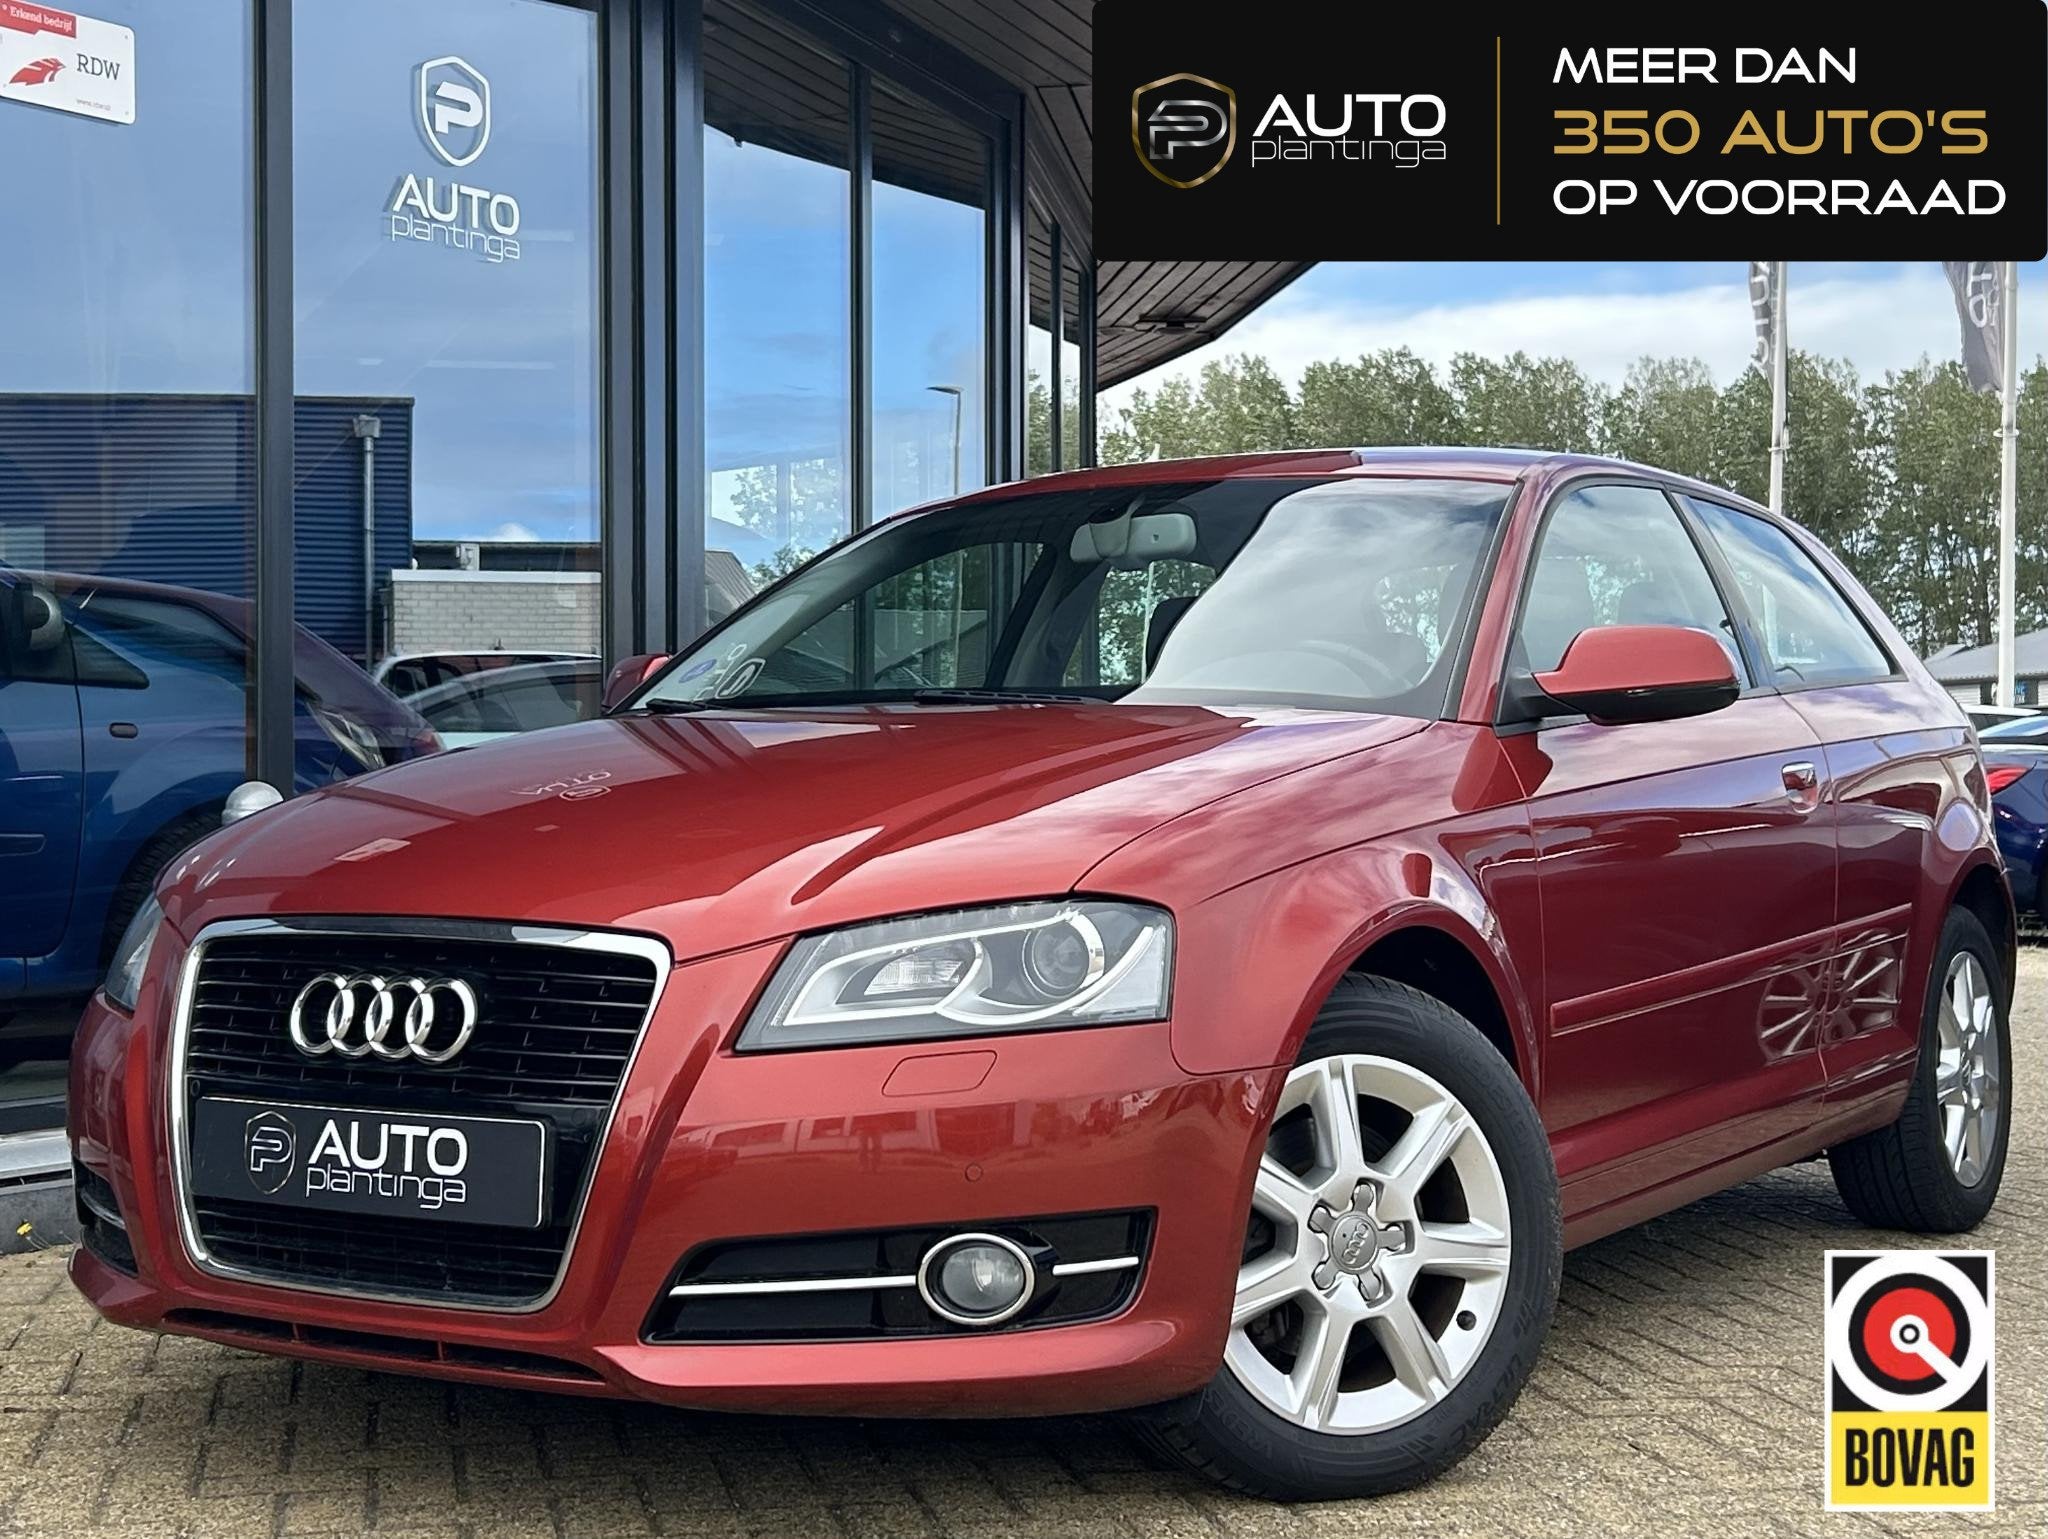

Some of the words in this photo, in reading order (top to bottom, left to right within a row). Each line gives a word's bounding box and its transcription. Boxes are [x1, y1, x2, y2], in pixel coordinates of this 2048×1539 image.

[9, 5, 42, 24] Erkend
[76, 53, 120, 80] RDW
[392, 173, 521, 236] AUTO
[391, 212, 521, 264] plantinga
[308, 1118, 468, 1177] AUTO
[305, 1163, 467, 1210] plantinga
